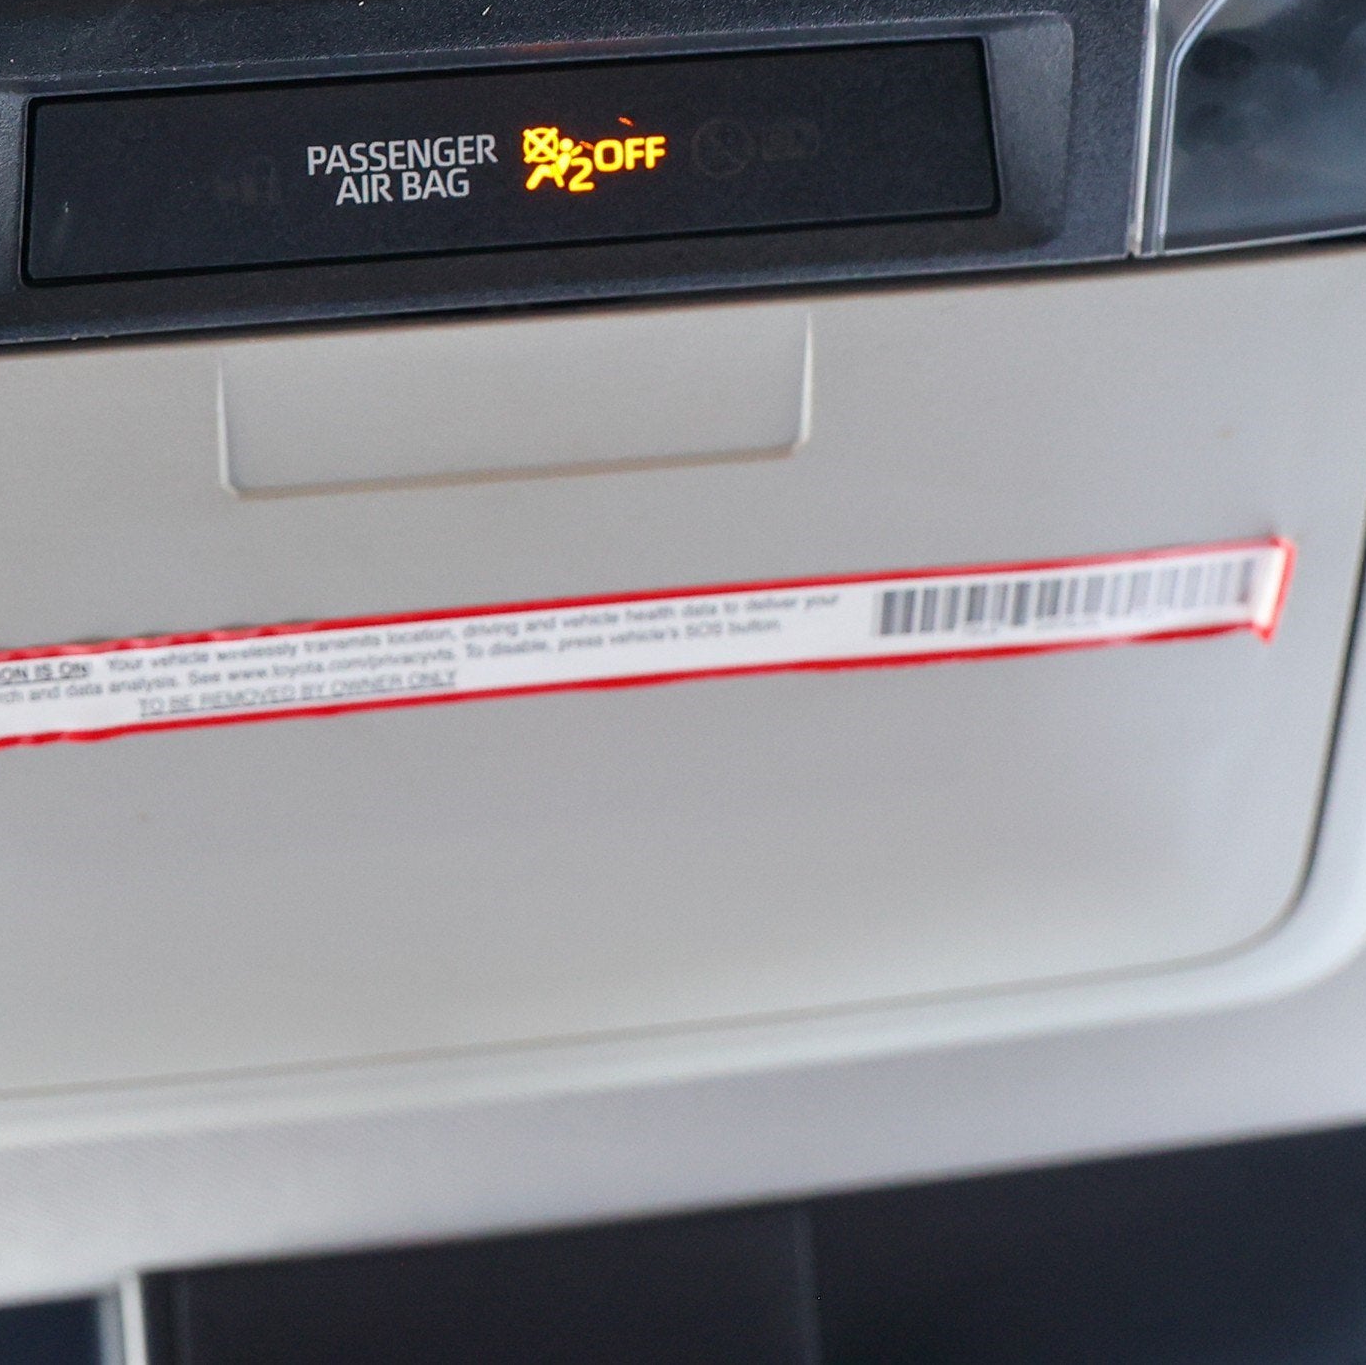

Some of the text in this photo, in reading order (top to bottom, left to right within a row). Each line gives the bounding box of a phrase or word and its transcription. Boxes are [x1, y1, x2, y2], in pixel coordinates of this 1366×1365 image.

[306, 134, 499, 176] PASSENGER
[593, 136, 667, 172] OFF
[336, 166, 470, 206] AIR BAG
[36, 662, 52, 680] IS
